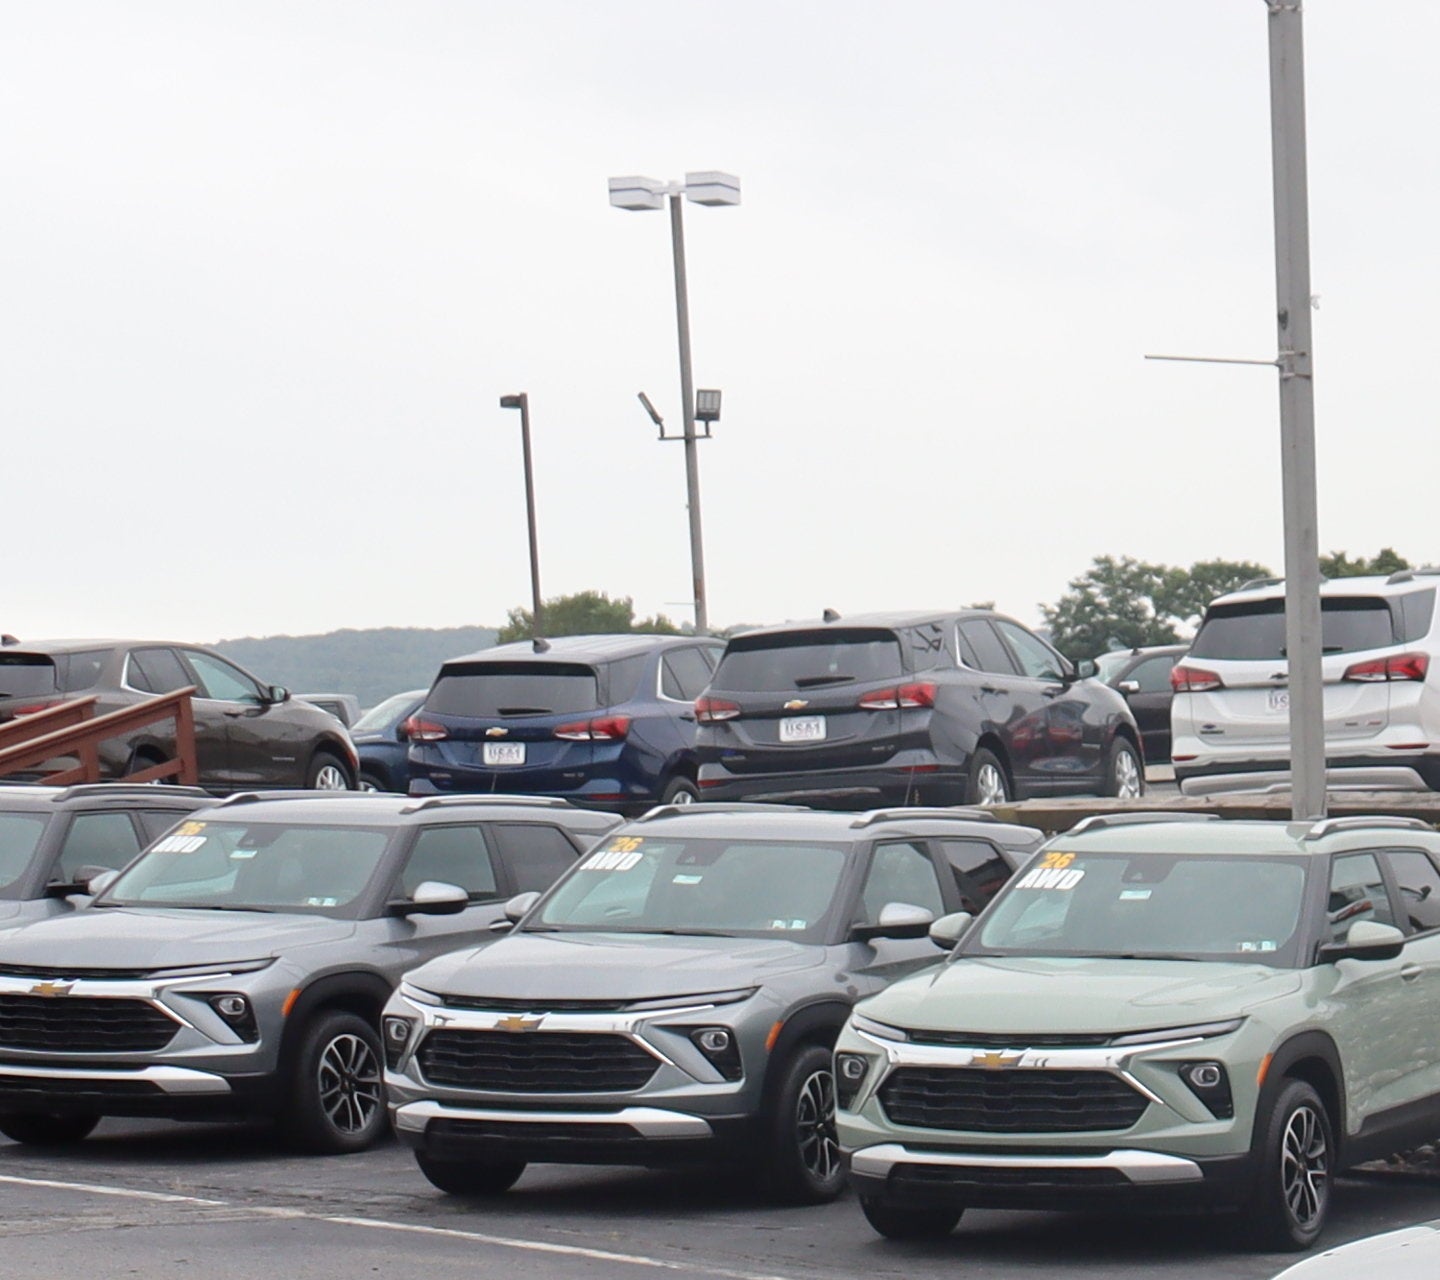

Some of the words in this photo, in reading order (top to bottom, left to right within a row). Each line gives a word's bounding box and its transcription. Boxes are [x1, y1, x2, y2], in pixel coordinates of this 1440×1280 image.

[579, 852, 643, 870] AWD
[1039, 852, 1076, 869] 26
[1015, 869, 1085, 890] AWD
